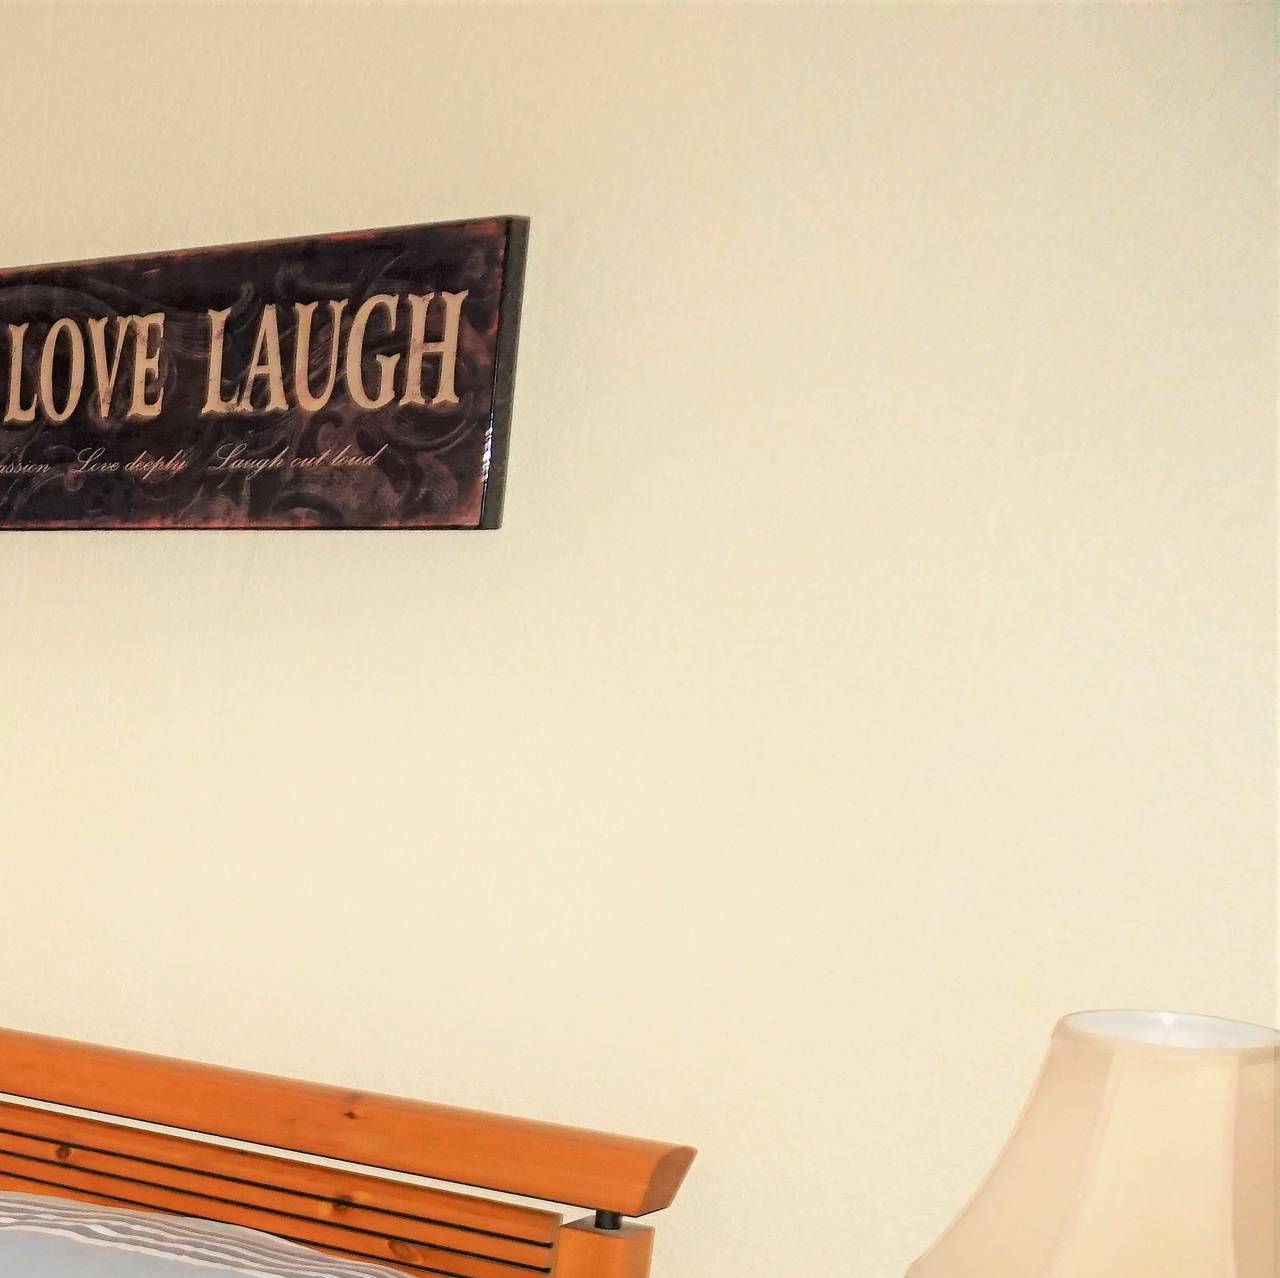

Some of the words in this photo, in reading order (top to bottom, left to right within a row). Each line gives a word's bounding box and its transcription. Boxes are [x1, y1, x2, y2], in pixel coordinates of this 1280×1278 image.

[3, 311, 166, 424] LOVE
[201, 289, 470, 414] LAUGH
[71, 447, 121, 474] Love
[124, 449, 188, 481] deeply
[208, 442, 290, 480] Laugh
[290, 449, 332, 468] out
[331, 443, 389, 466] loud
